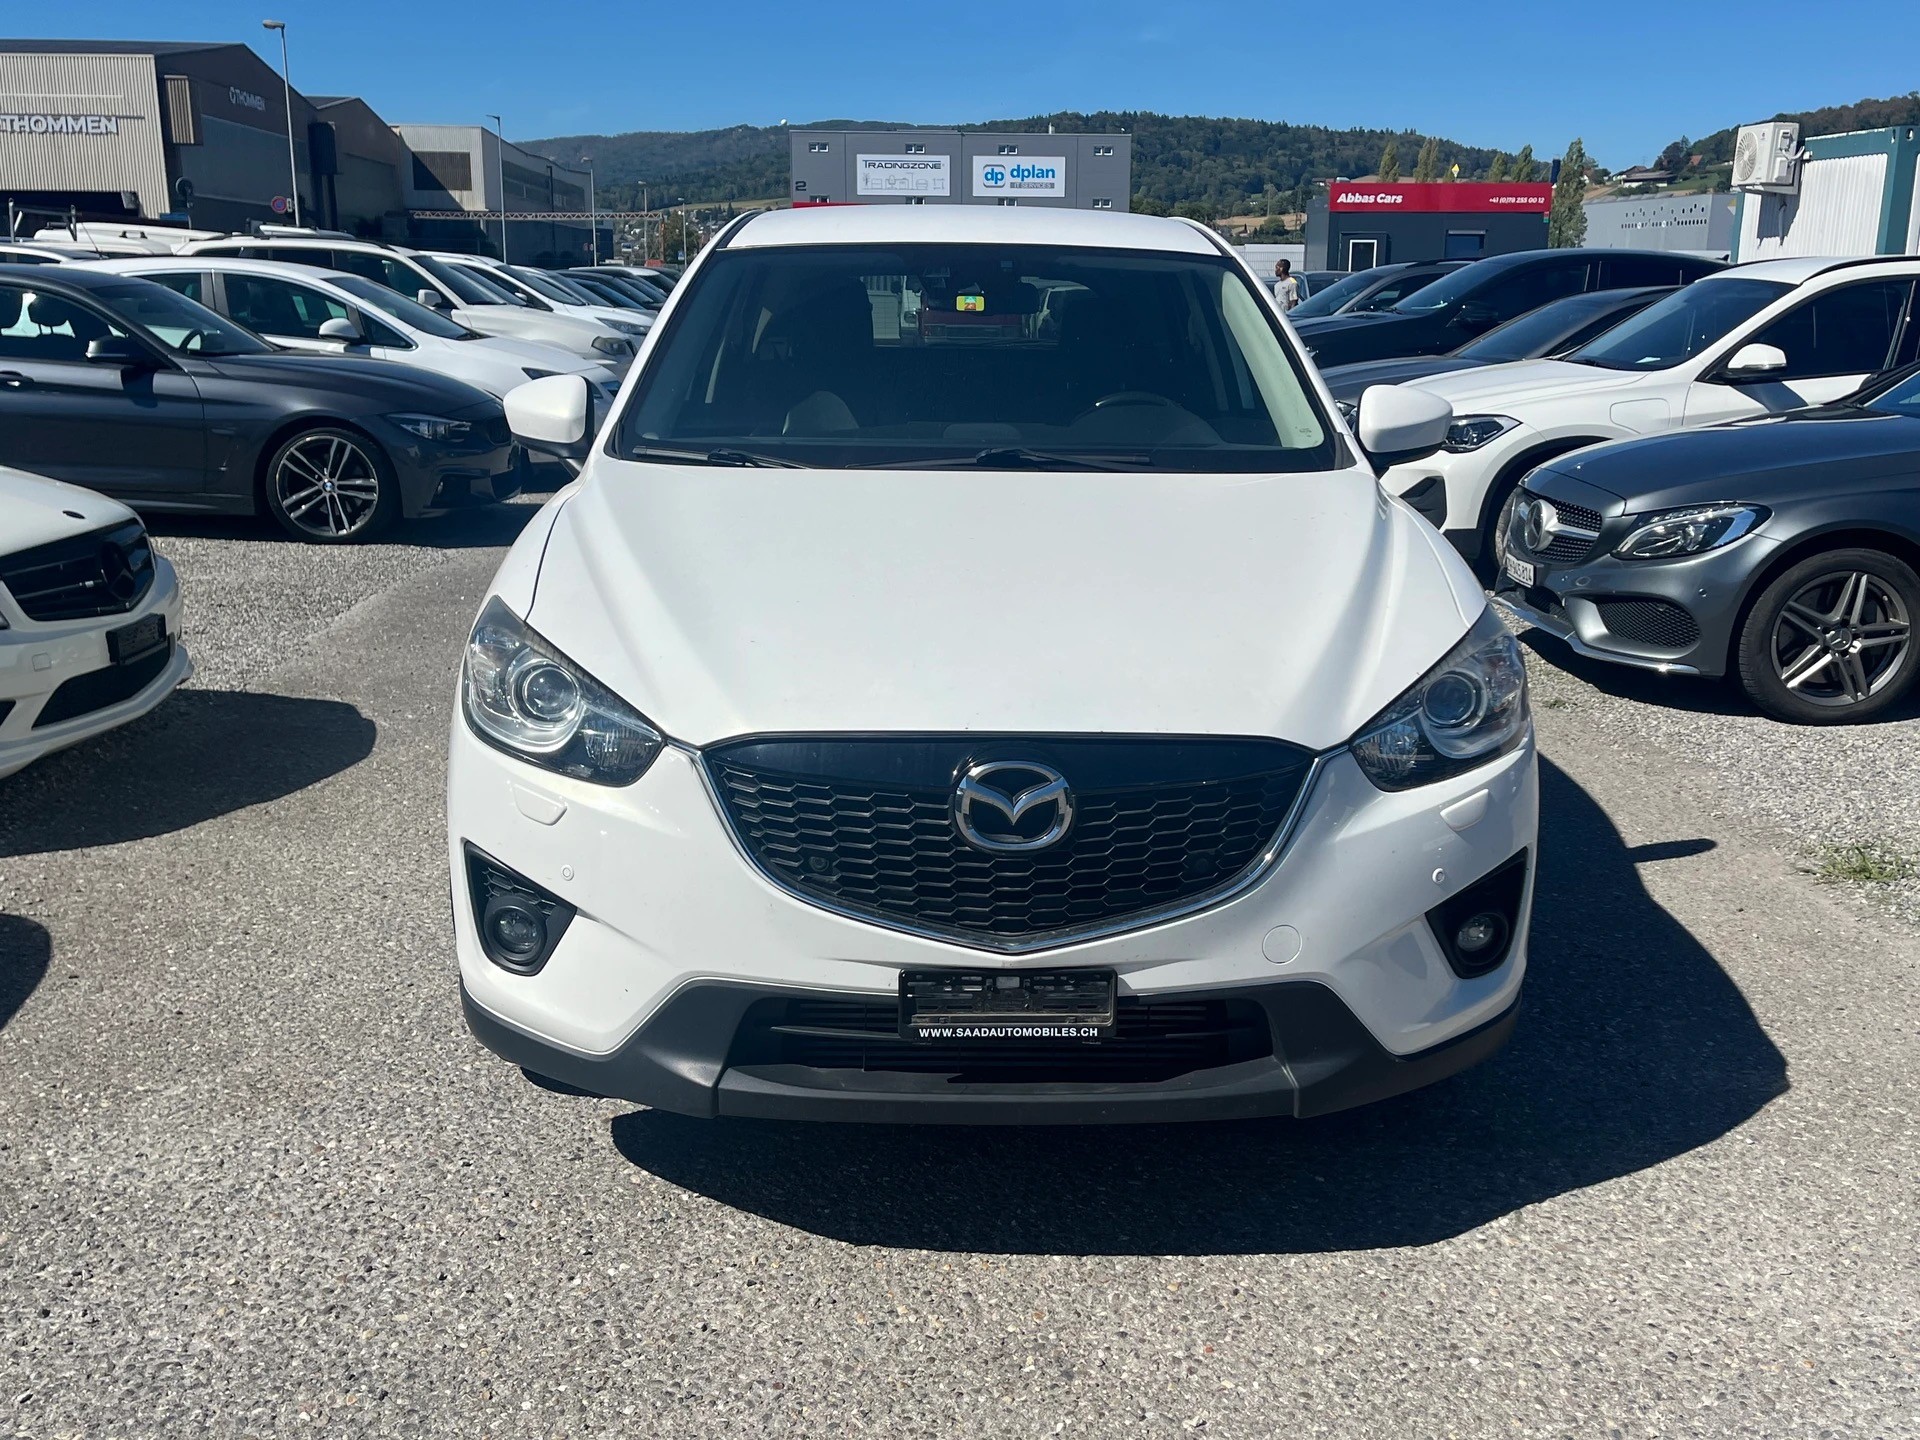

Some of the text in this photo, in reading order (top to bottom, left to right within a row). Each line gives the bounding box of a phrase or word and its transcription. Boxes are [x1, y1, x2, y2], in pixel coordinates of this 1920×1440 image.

[0, 115, 118, 134] THOMMEN
[984, 168, 1005, 184] dp
[1010, 164, 1056, 181] dplan
[795, 180, 807, 191] 2
[1337, 193, 1403, 203] Abbas Cars
[918, 1027, 1098, 1038] WWW.SAADAUTOMOBILES.CH
